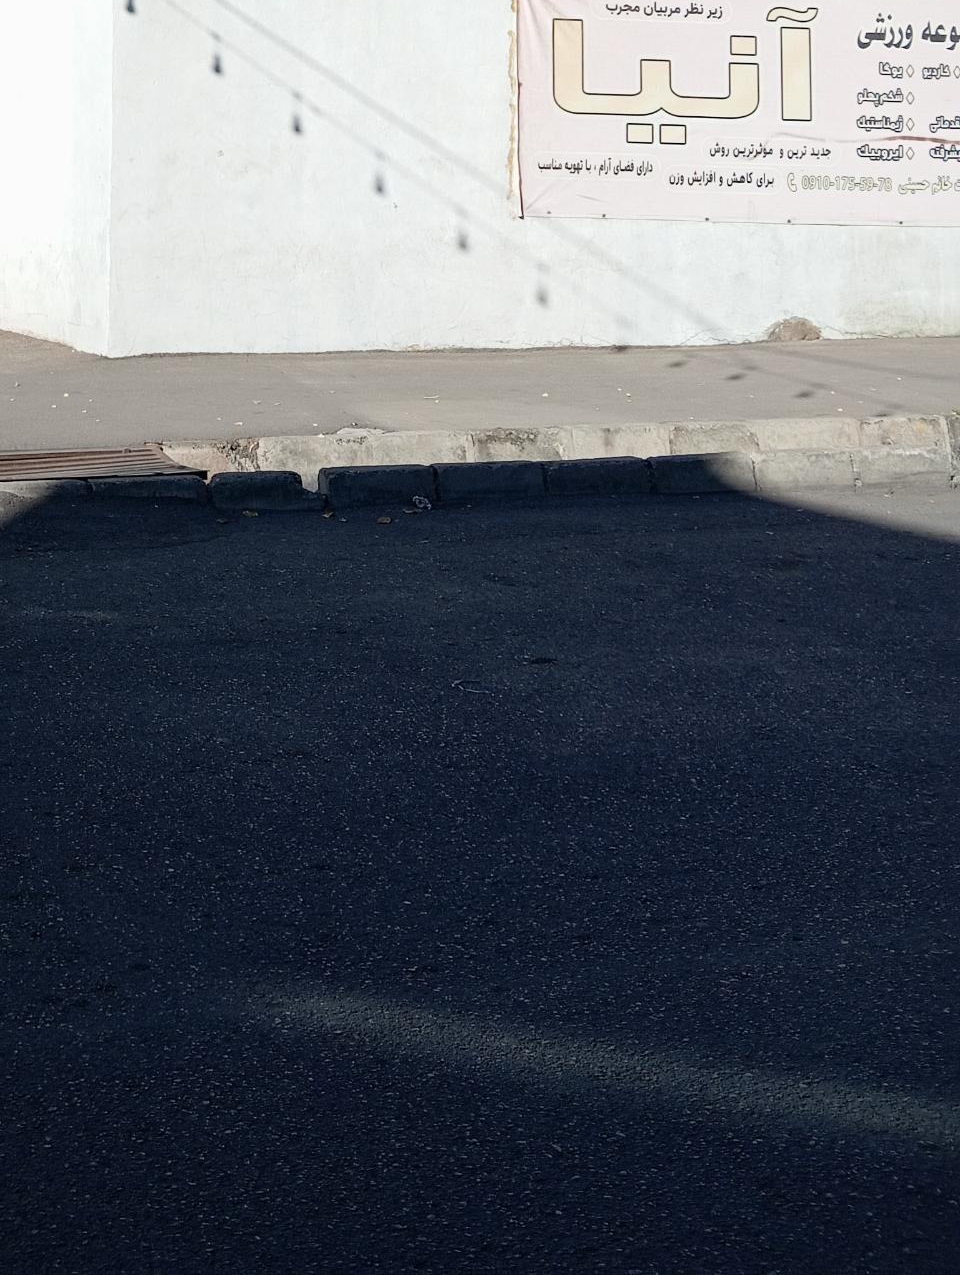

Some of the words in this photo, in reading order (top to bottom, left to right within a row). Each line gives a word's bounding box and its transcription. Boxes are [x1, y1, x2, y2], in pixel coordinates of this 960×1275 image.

[605, 3, 640, 16] مجرب
[643, 1, 681, 18] مربیان
[684, 2, 704, 18] نظر
[707, 6, 723, 19] زیر
[857, 12, 913, 50] ورزشی
[921, 20, 960, 51] وعه
[552, 6, 819, 145] آنیا
[929, 115, 960, 133] قدماتی
[709, 142, 730, 157] روش
[779, 148, 784, 159] و
[787, 146, 807, 159] ترین
[810, 147, 832, 160] جدید
[929, 143, 960, 162] شرفته
[538, 158, 562, 173] مناسب
[564, 160, 583, 174] تهویه
[585, 159, 592, 174] با
[598, 157, 612, 176] آرام
[613, 159, 635, 175] فضای
[636, 160, 653, 176] دارای
[668, 174, 685, 185] وزن
[687, 171, 716, 186] افزایش
[719, 175, 723, 186] و
[726, 172, 753, 186] کاهش
[756, 173, 775, 188] برای
